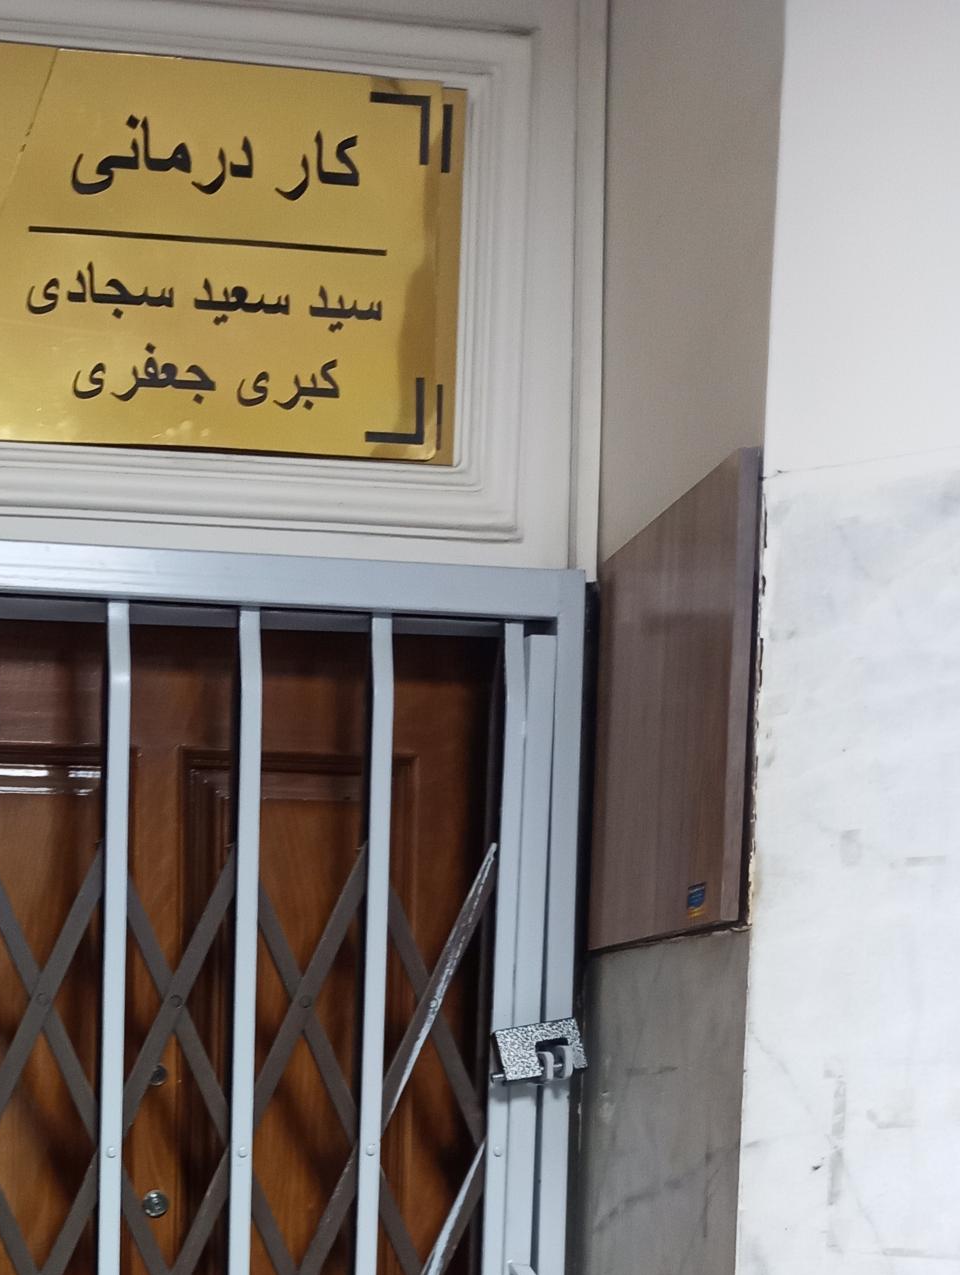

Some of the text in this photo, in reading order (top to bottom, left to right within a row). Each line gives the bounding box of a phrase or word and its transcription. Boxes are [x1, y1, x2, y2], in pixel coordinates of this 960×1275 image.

[71, 114, 360, 201] کار درمانی
[27, 262, 382, 333] سید سعید سجادی
[73, 343, 340, 410] کبری جعفری
